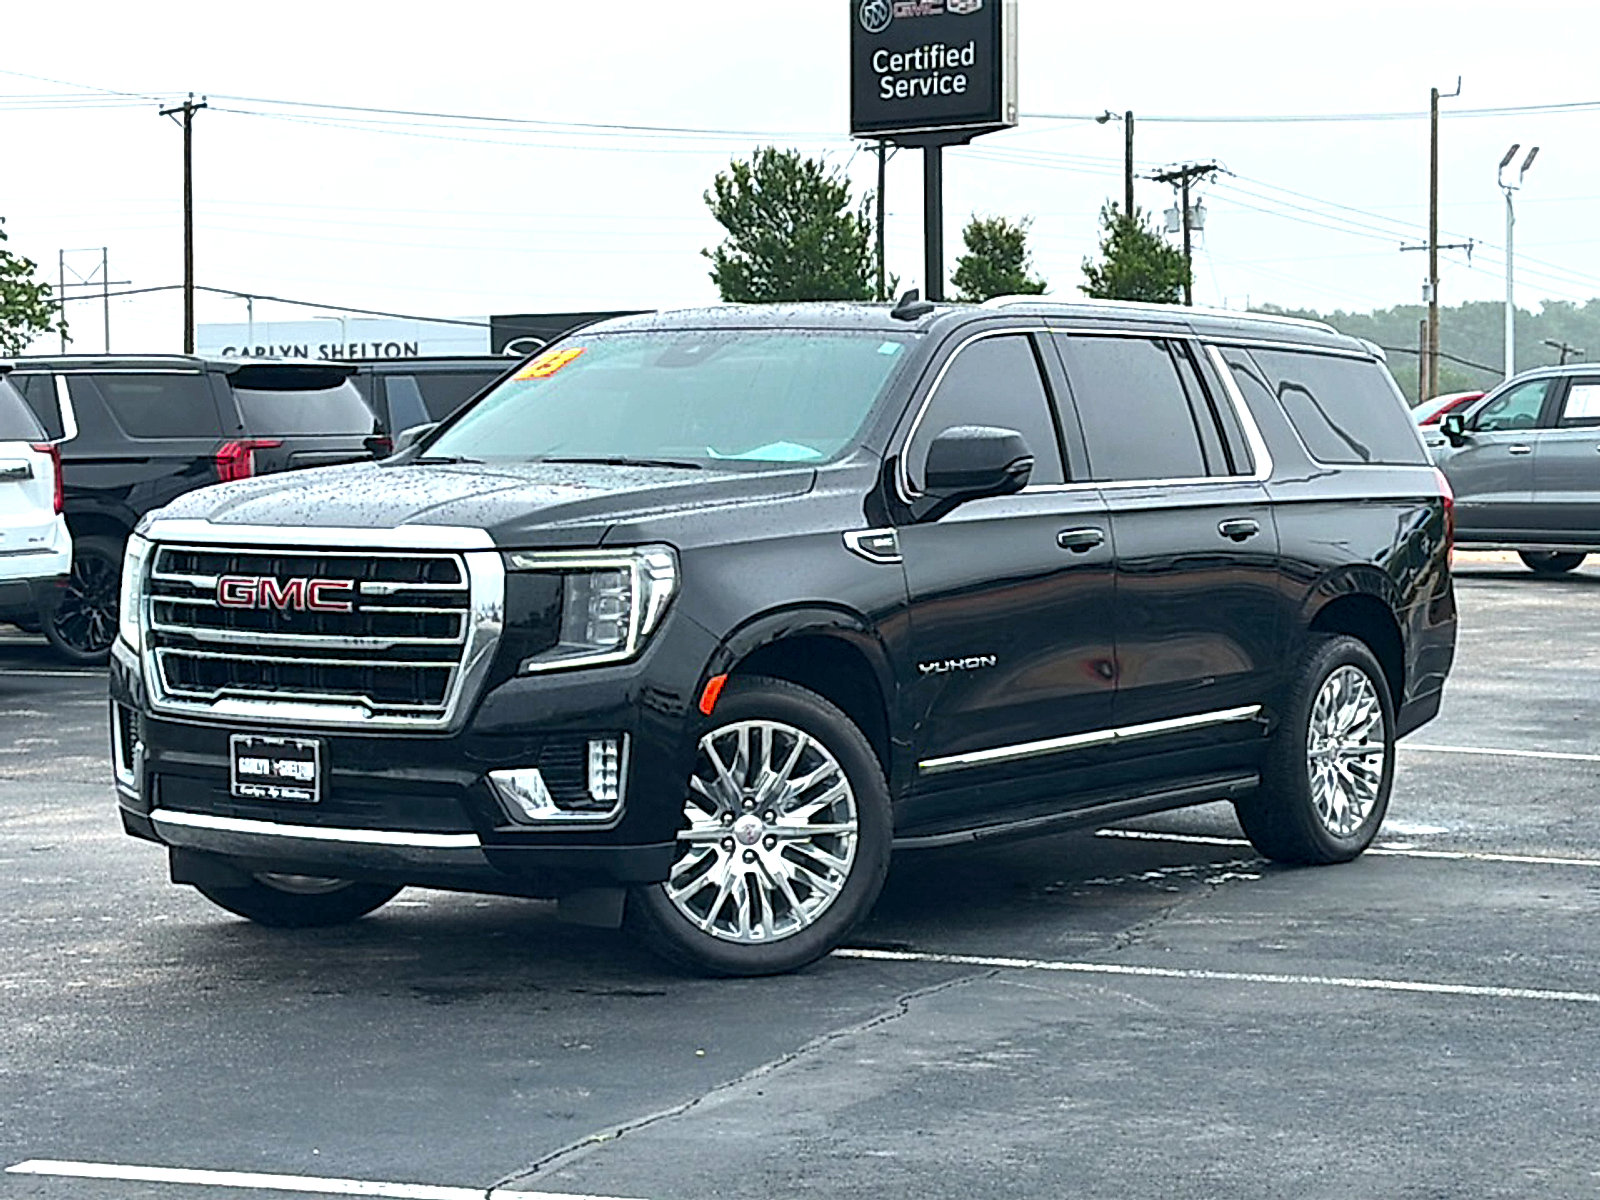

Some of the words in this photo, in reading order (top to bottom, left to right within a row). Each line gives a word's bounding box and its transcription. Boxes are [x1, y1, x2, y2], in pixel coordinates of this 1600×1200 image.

[873, 41, 975, 73] Certified
[880, 71, 967, 99] Service
[217, 575, 355, 612] GMC
[918, 655, 997, 674] YUKON
